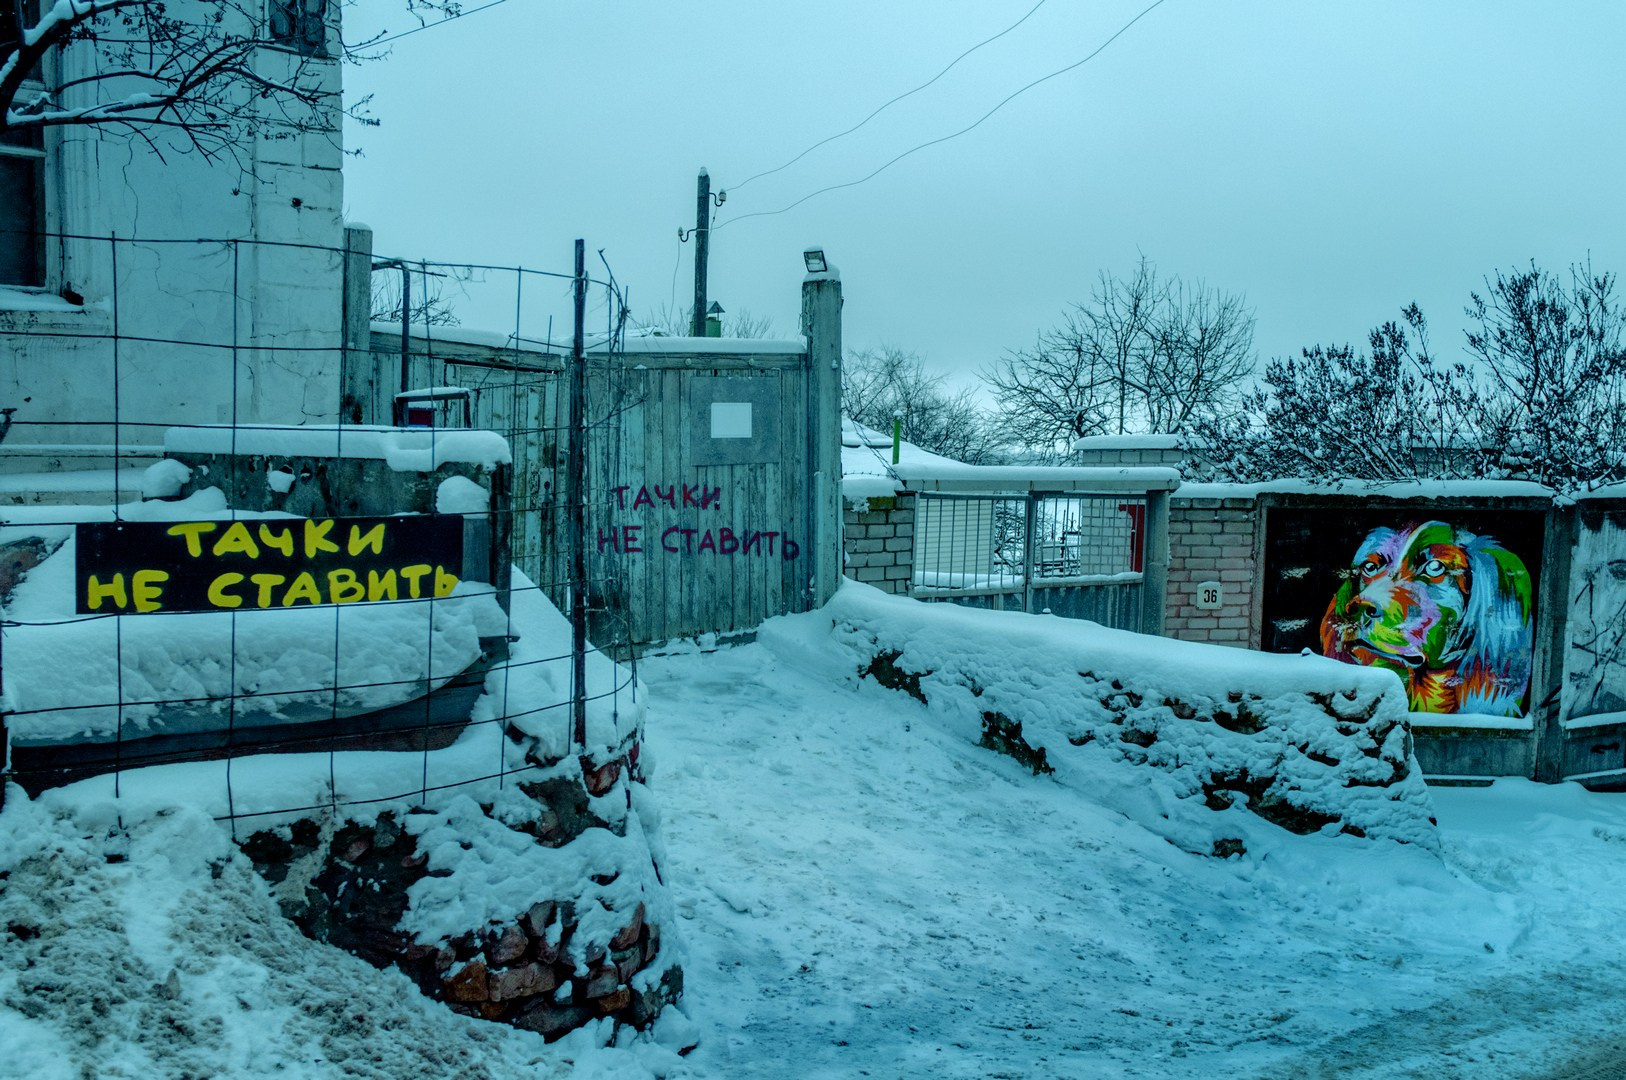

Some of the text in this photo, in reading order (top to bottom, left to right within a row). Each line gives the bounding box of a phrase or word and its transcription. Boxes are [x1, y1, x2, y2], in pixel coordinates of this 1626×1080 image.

[610, 483, 721, 510] ТАЧКИ
[167, 519, 386, 559] ТАЧКИ
[597, 525, 800, 561] НЕ СТАВИТЬ
[87, 564, 460, 612] НЕ СТАВИТЬ
[1203, 589, 1218, 603] 36
